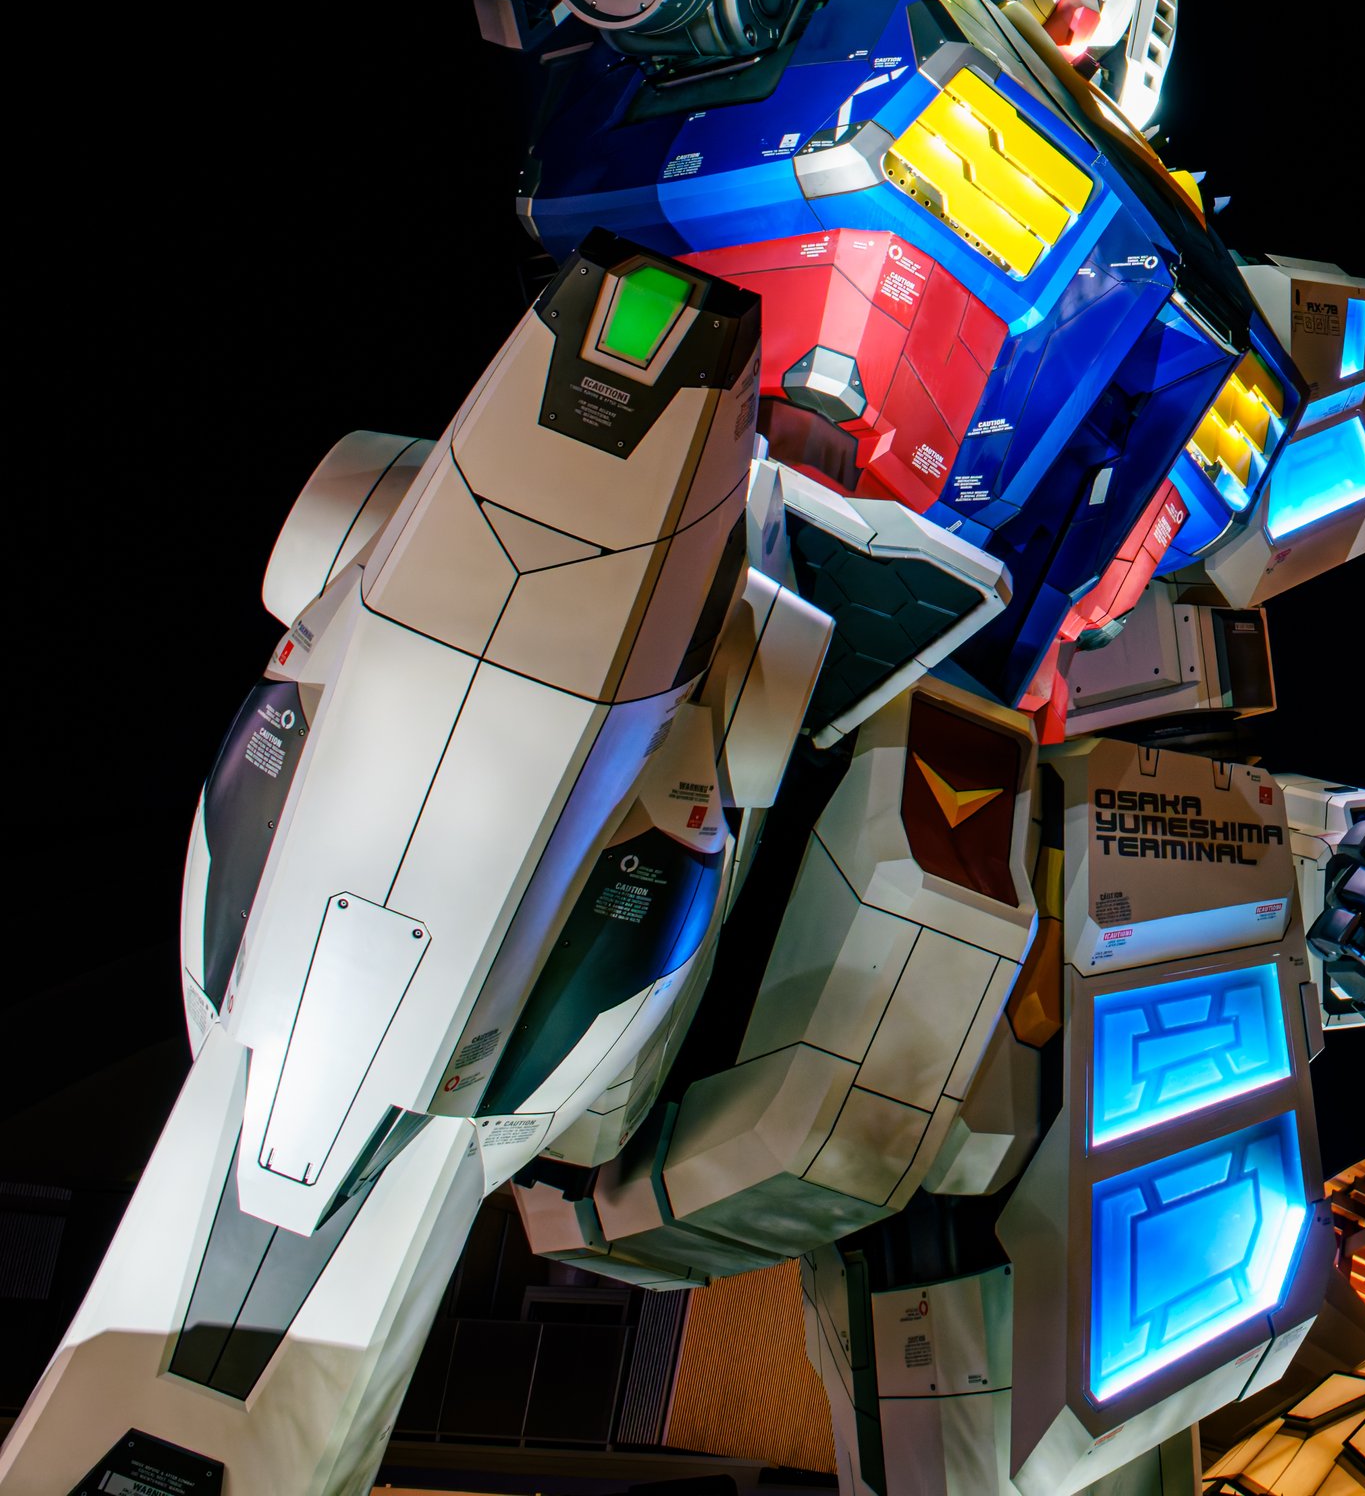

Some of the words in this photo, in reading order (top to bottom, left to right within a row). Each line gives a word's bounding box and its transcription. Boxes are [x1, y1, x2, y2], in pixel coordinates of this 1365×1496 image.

[1306, 302, 1339, 315] RX-78
[977, 418, 1006, 428] CAUTION
[921, 444, 944, 463] CAUTION
[259, 727, 283, 748] CAUTION
[1095, 788, 1202, 817] OSAKA
[1096, 811, 1283, 845] YUMESHIMA
[1096, 834, 1258, 866] TERMINAL
[615, 882, 649, 896] CAUTION
